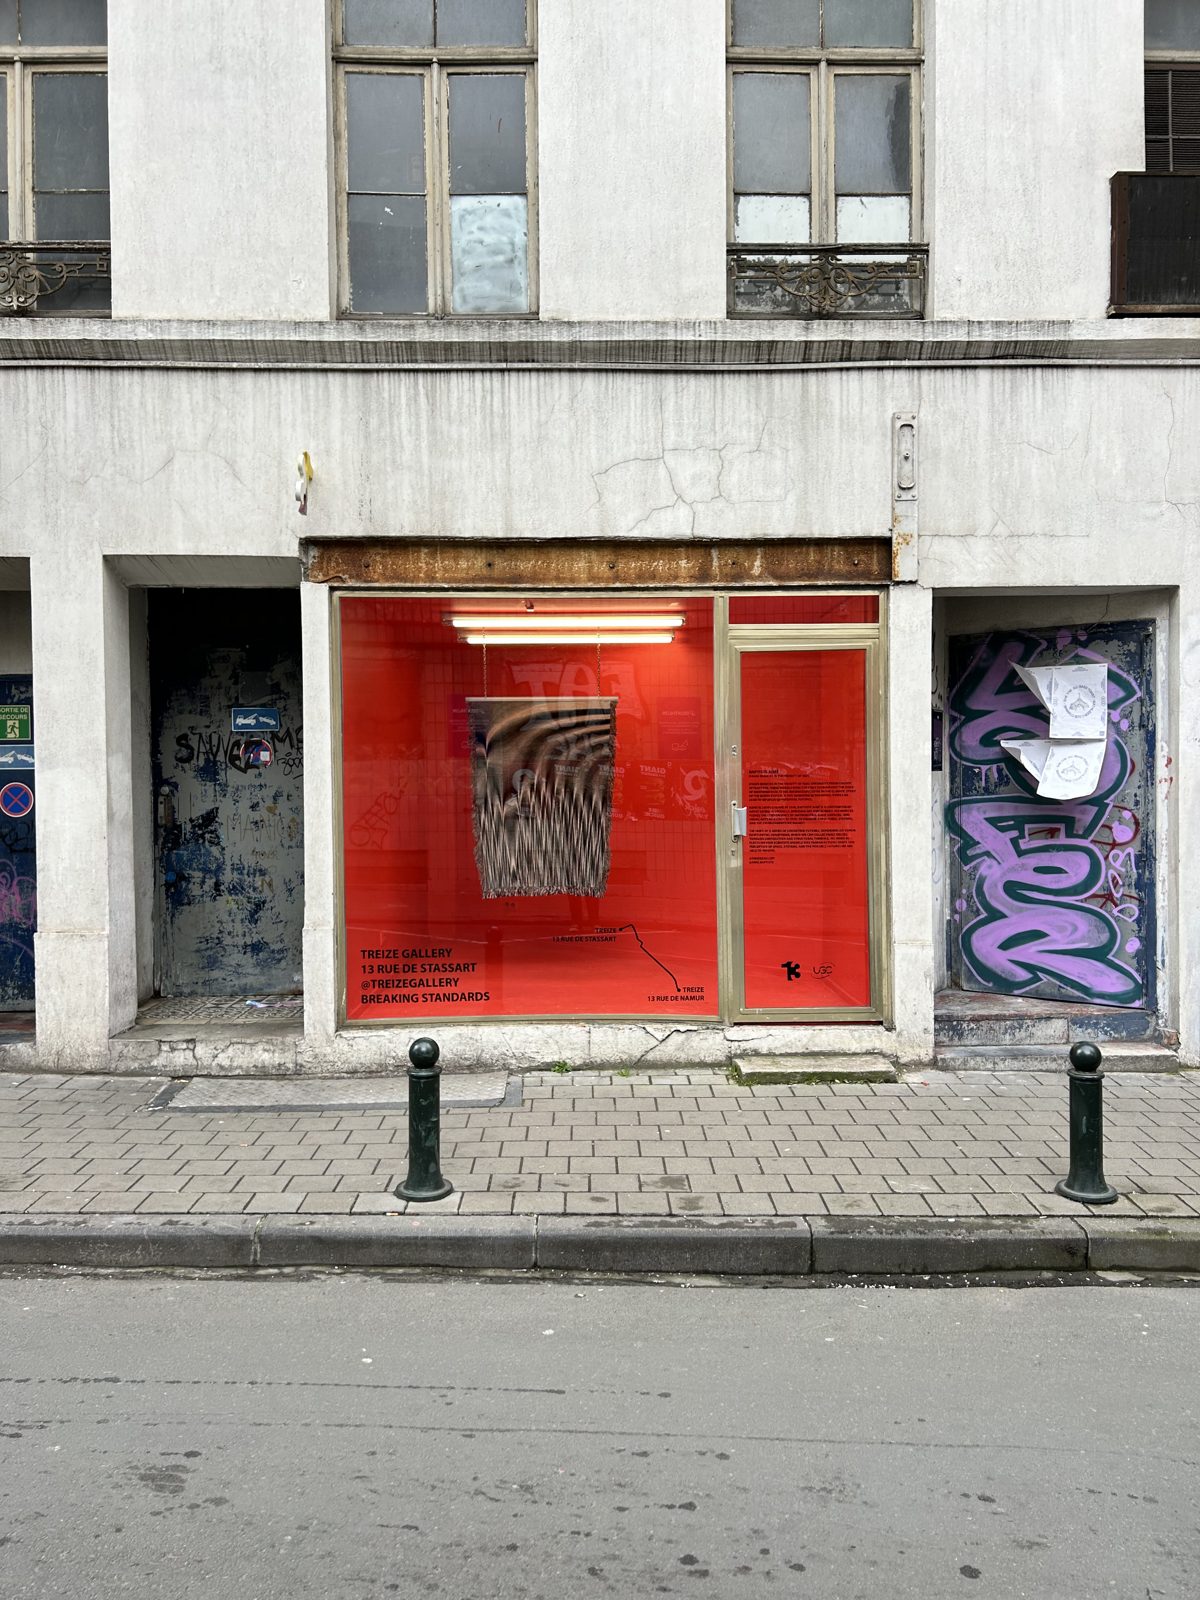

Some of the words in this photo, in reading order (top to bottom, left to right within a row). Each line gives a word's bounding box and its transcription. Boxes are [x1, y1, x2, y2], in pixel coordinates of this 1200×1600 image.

[360, 949, 399, 959] TREIZE
[402, 948, 453, 959] GALLERY
[362, 964, 375, 974] 13
[377, 964, 400, 974] RUE
[402, 963, 418, 973] DE
[420, 962, 478, 973] STASSART
[361, 977, 460, 990] @TREIZEGALLERY
[361, 993, 419, 1004] BREAKING
[421, 992, 490, 1003] STANDARDS
